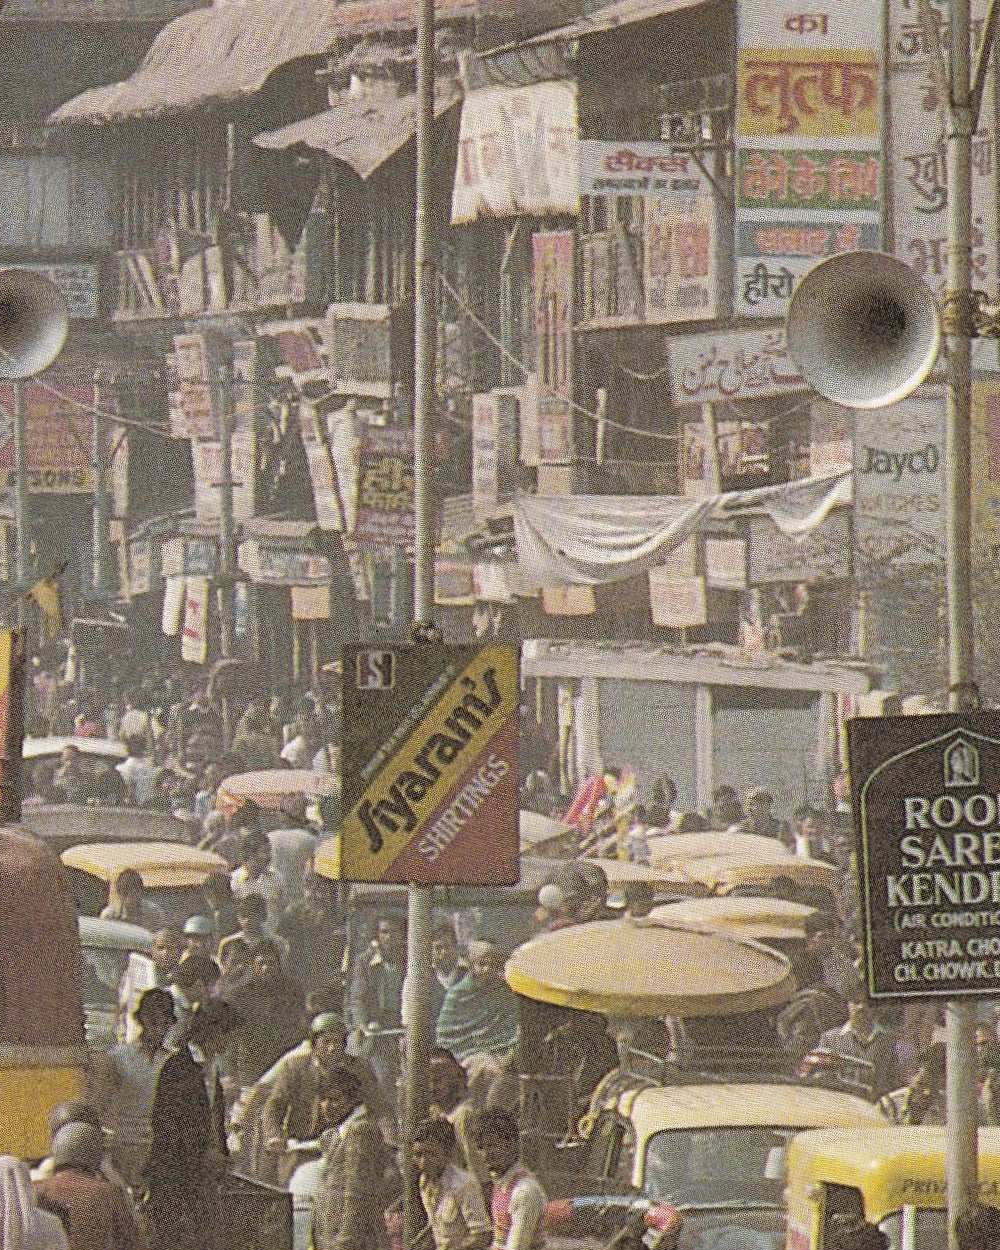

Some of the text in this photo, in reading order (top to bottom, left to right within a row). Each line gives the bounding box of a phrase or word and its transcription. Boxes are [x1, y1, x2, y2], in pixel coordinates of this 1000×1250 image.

[357, 667, 502, 854] Siyaram's
[418, 754, 510, 863] SHIRTINGS
[904, 794, 1000, 830] ROO
[900, 939, 963, 960] KATRA
